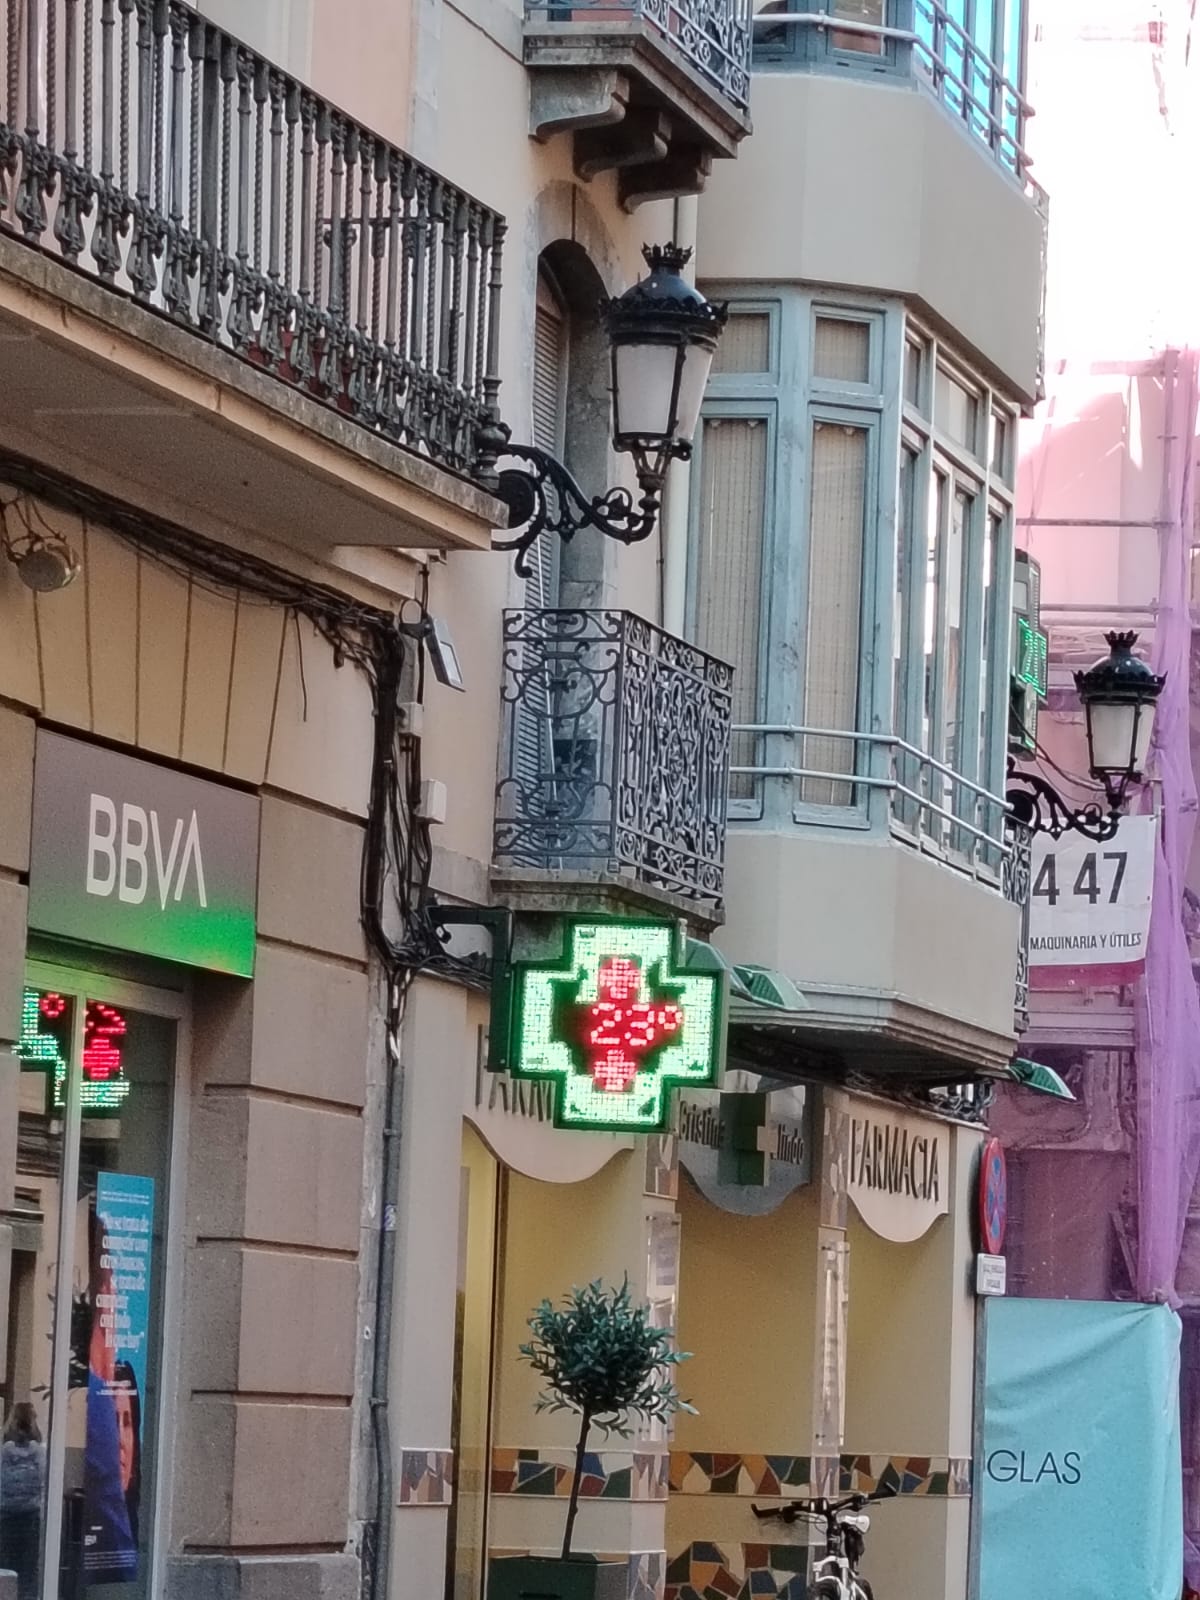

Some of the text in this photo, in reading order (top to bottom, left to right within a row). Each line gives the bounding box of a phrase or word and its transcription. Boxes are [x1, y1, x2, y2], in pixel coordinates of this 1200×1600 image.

[86, 793, 208, 911] BBVA
[1030, 932, 1142, 950] MAQUINARIA Y ÚTILES
[850, 1118, 940, 1203] FARMACIA
[987, 1449, 1081, 1484] GLAS
